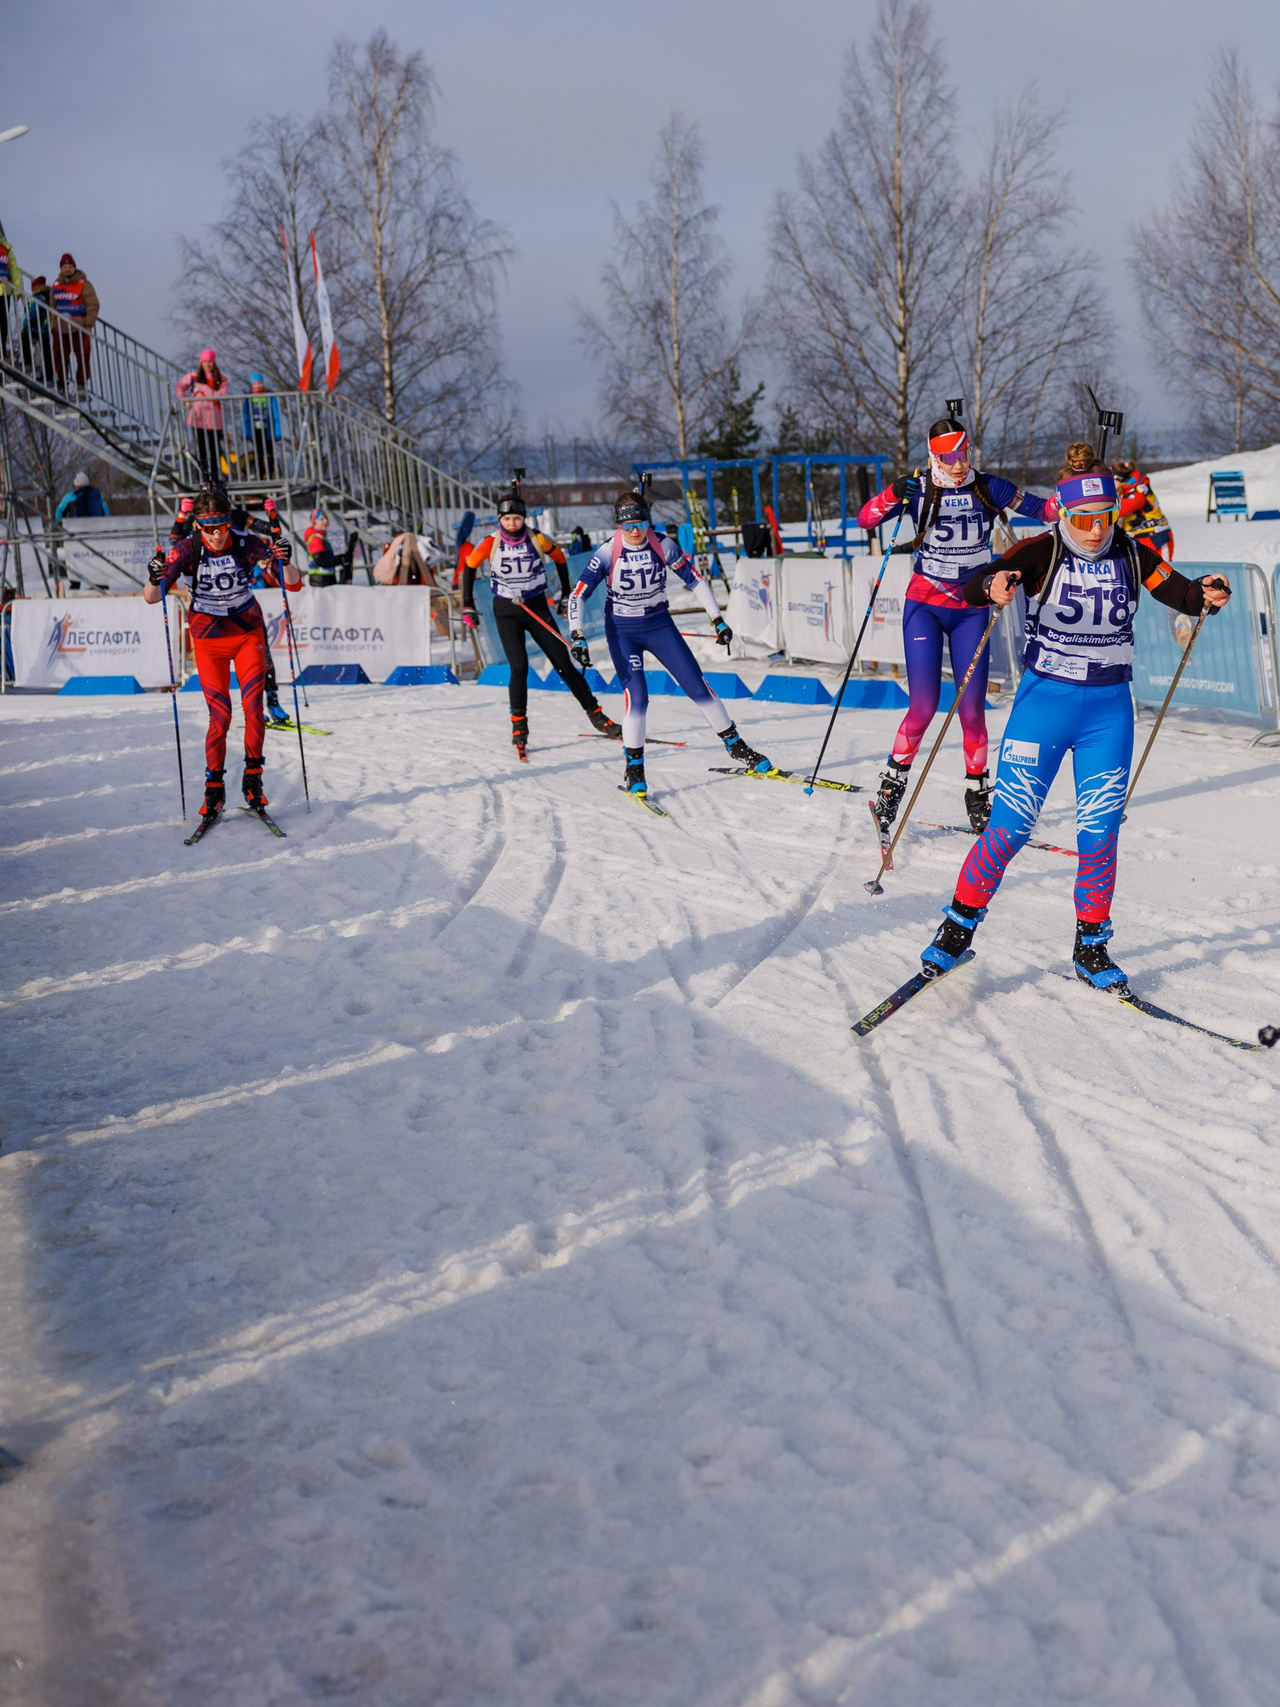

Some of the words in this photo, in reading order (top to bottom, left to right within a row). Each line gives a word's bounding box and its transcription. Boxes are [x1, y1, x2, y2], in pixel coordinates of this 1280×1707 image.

[944, 498, 969, 507] VEKA
[935, 512, 983, 542] 511
[629, 553, 650, 562] VEKA
[500, 555, 534, 574] 517
[1078, 562, 1111, 575] VEKA
[620, 563, 663, 591] 514
[1055, 583, 1130, 627] 518
[67, 631, 141, 645] ЛЕСГАФТА
[90, 647, 139, 656] университет
[313, 643, 384, 653] университет
[1011, 755, 1037, 765] GAZPROM
